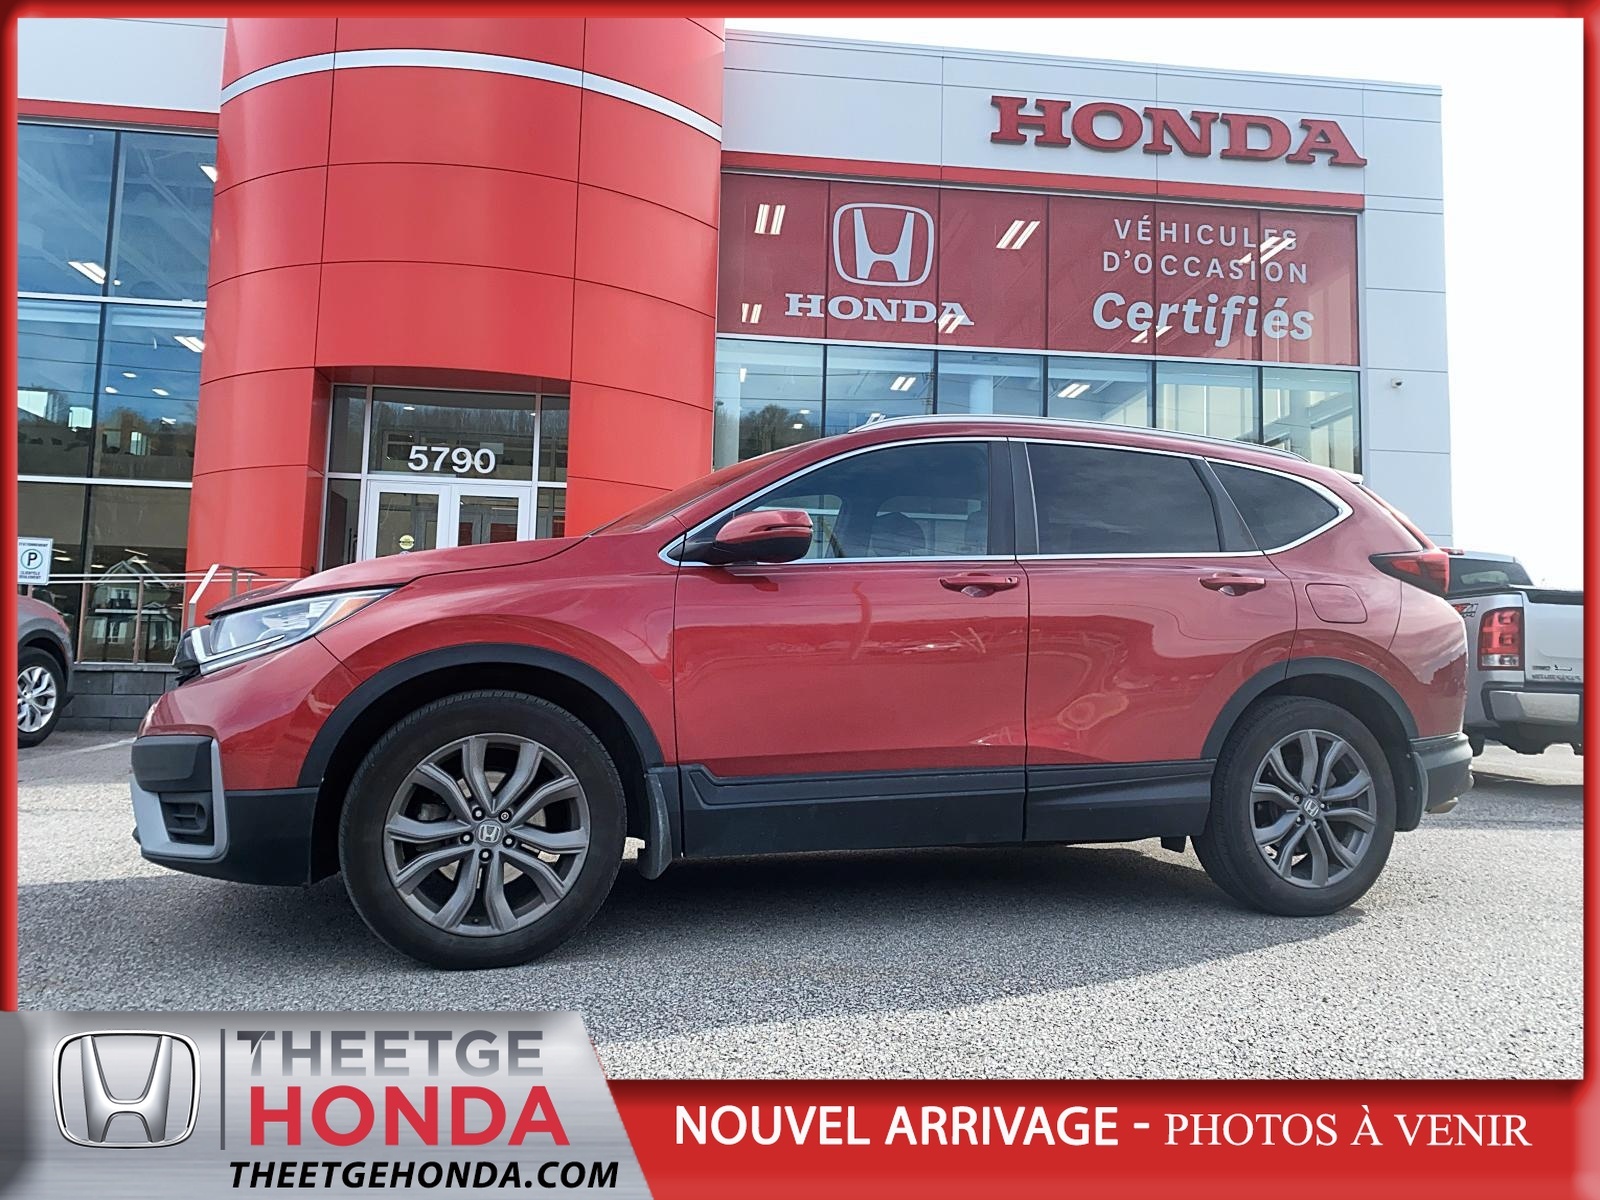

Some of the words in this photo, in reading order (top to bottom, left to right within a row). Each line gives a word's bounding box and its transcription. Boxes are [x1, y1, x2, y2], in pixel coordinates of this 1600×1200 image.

[991, 96, 1367, 167] HONDA
[1114, 215, 1297, 250] VÉHICULES
[1103, 250, 1307, 284] D'OCCASION
[784, 293, 975, 326] HONDA
[1093, 292, 1314, 347] Certifiés
[407, 445, 496, 474] 5790
[27, 552, 38, 567] P
